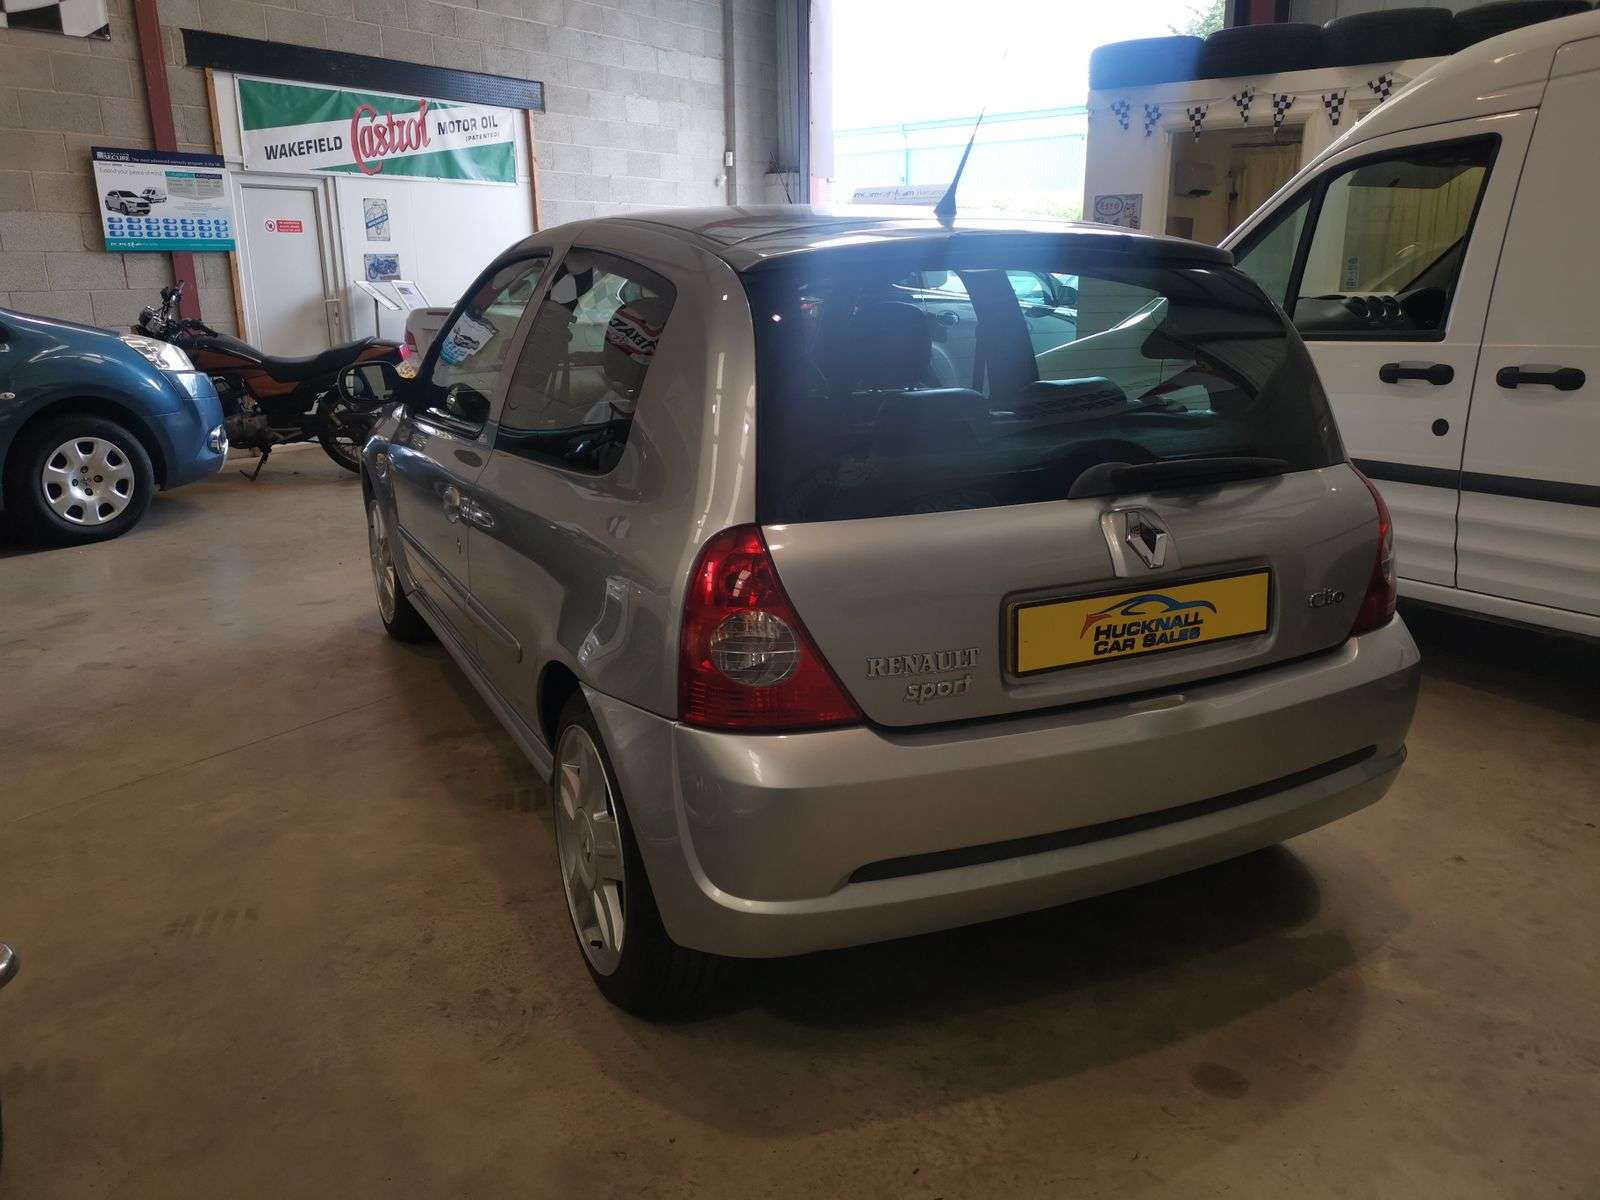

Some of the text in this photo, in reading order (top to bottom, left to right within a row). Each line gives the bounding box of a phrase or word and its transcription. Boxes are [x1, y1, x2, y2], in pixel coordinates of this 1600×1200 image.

[264, 99, 498, 176] WAKEFIELD Castrol MOTOR OIL
[1094, 612, 1204, 642] HUCKNALL
[1094, 627, 1201, 655] CAR SALES
[866, 647, 980, 677] RENAULT
[905, 675, 973, 704] sport
